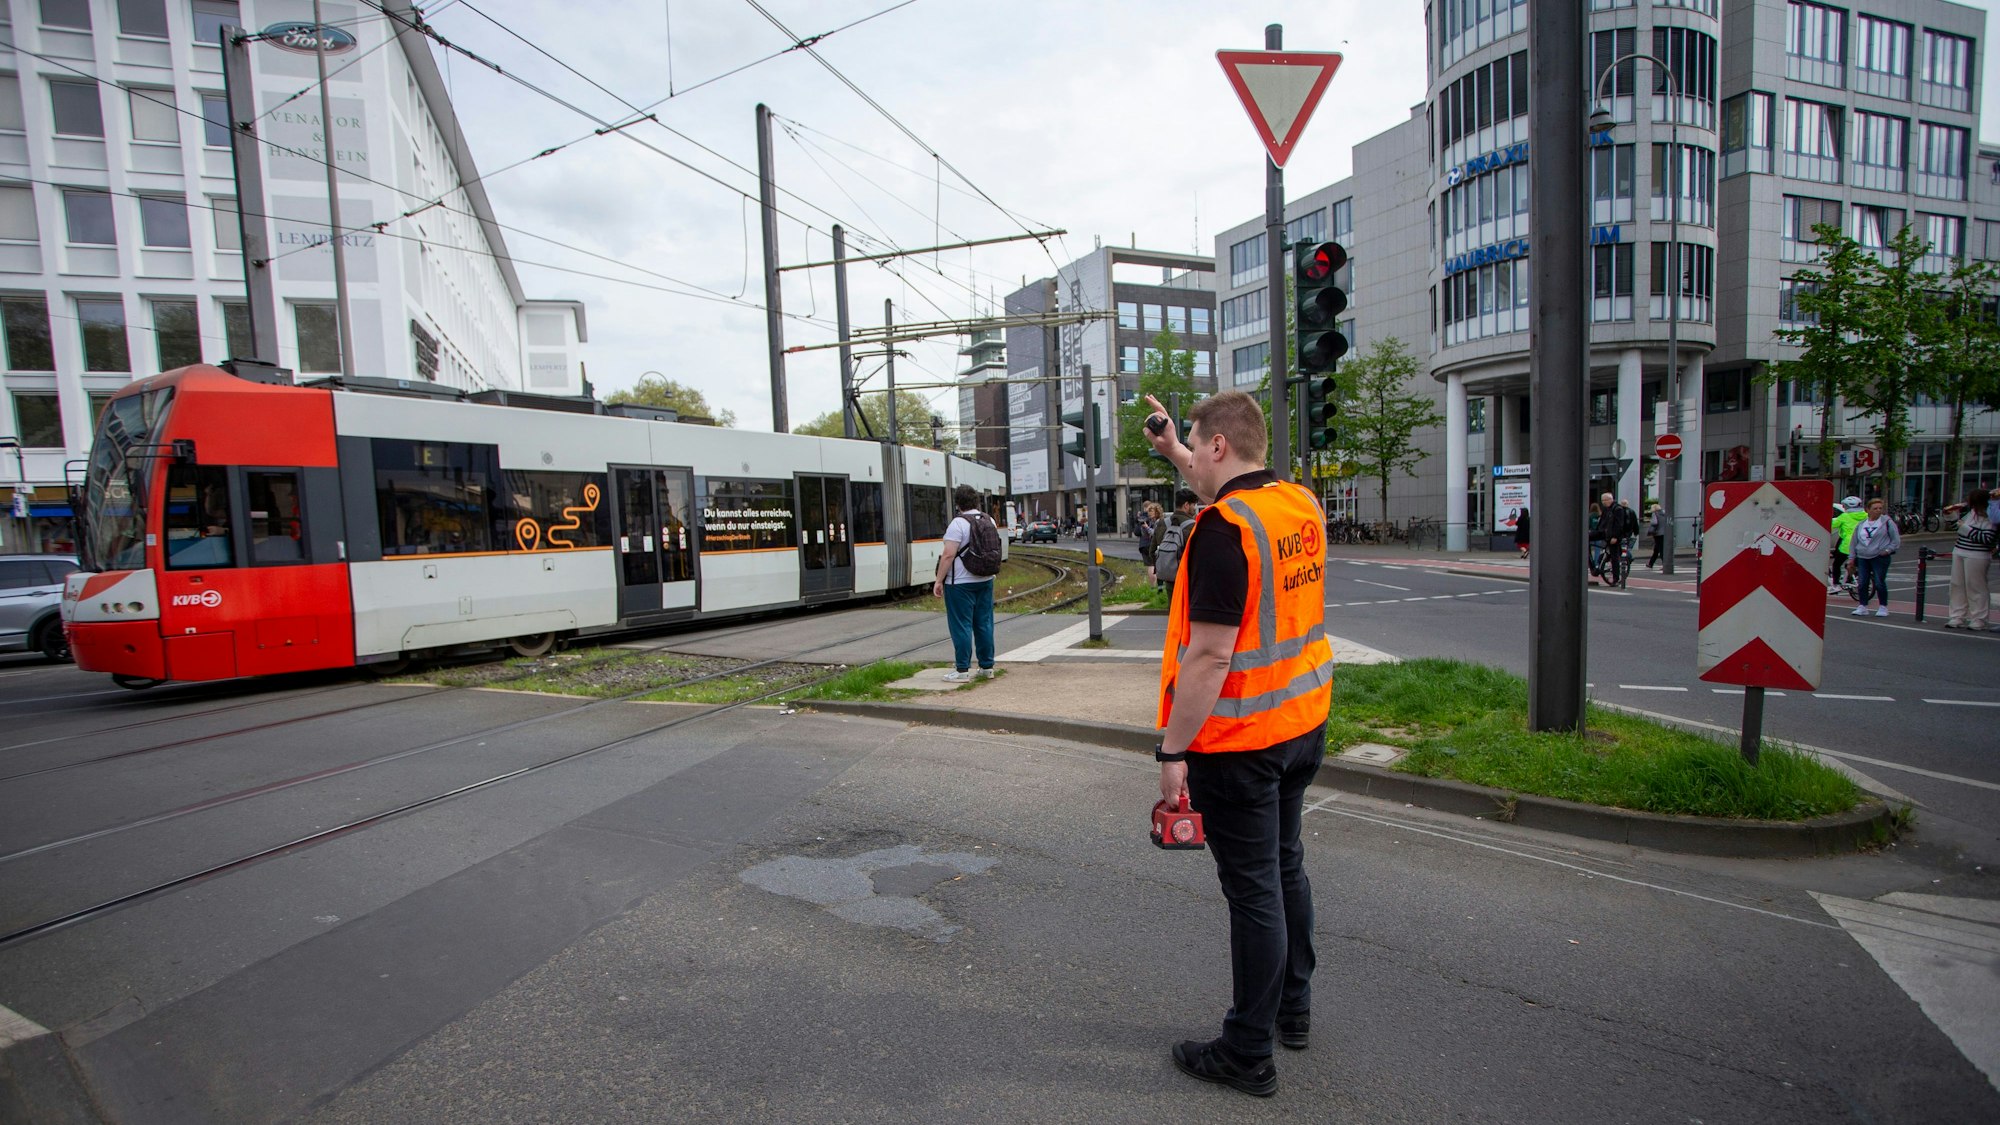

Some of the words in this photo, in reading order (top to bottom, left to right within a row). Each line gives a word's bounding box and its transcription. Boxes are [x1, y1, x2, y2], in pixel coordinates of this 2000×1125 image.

[283, 27, 335, 49] Ford
[270, 111, 361, 128] VENAOR
[269, 146, 368, 161] HANSEIN
[423, 447, 433, 465] E
[704, 508, 716, 518] Du
[716, 508, 742, 518] kannst
[743, 508, 760, 518] alles
[760, 508, 792, 518] erreichen,
[705, 523, 726, 531] wenn
[727, 521, 736, 530] du
[738, 523, 750, 531] nur
[751, 521, 786, 531] einsteigst.
[1862, 526, 1878, 539] Y
[1277, 532, 1303, 561] KVB
[1283, 562, 1324, 592] Aufsich
[172, 594, 201, 606] KVB
